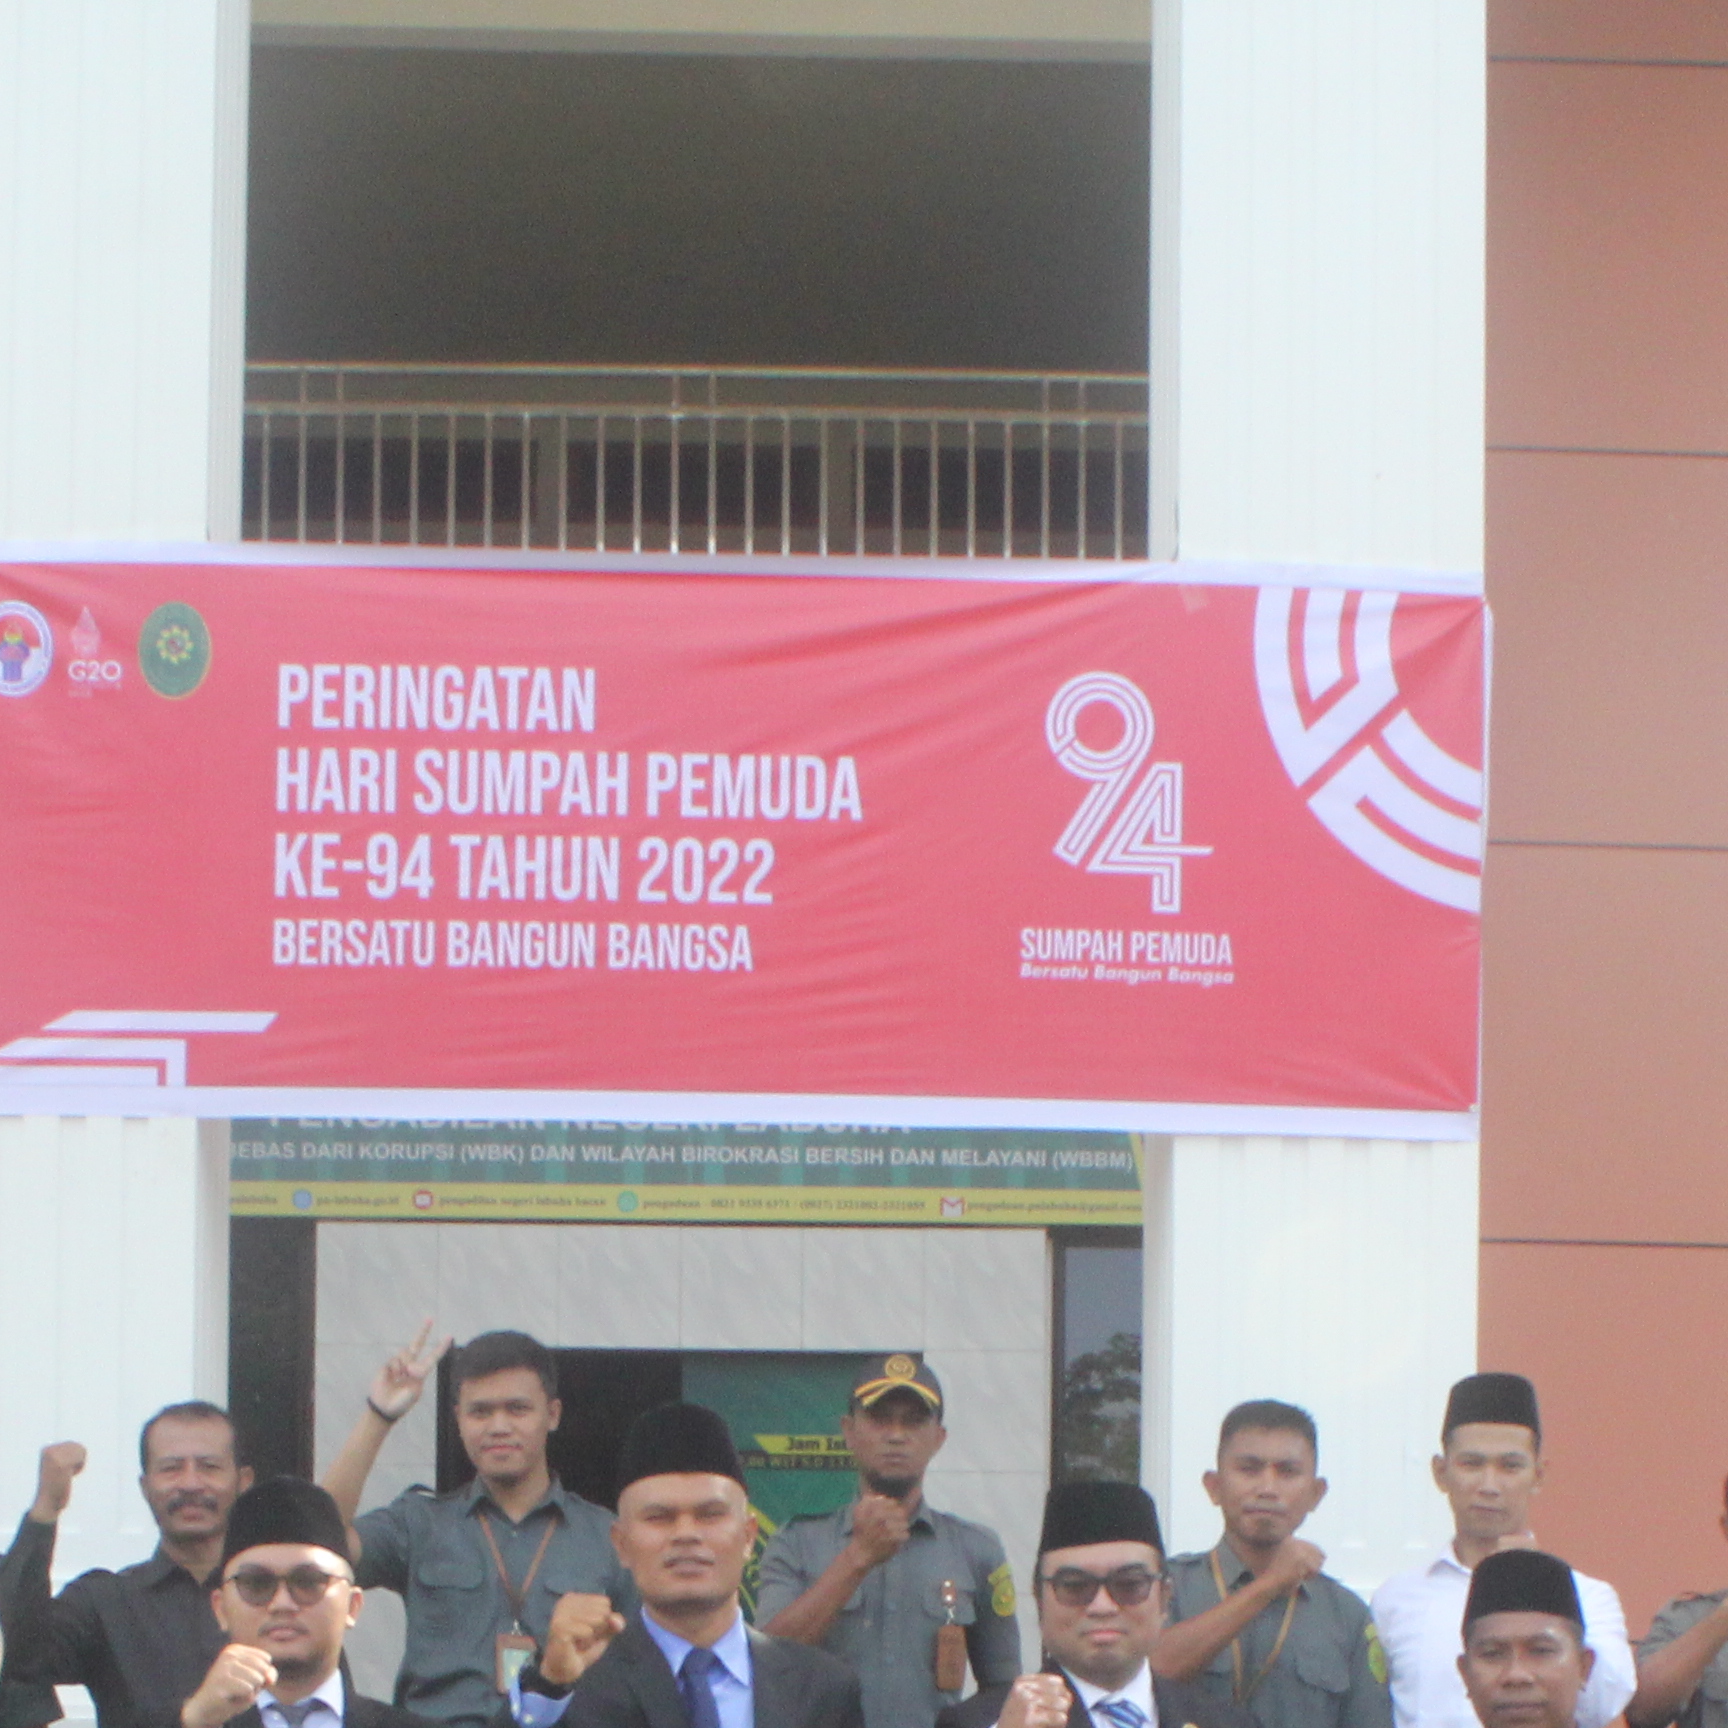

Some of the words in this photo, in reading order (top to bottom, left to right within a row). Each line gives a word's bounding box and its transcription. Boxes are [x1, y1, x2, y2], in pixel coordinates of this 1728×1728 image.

[68, 660, 123, 683] G20
[277, 664, 595, 732] PERINGATAN
[275, 748, 398, 813] HARI
[413, 750, 629, 817] SUMPAH
[646, 753, 863, 822] PEMUDA
[1045, 671, 1214, 914] 94
[273, 833, 435, 900] KE-94
[449, 835, 620, 902] TAHUN
[636, 837, 774, 905] 2022
[273, 920, 436, 967] BERSATU
[446, 921, 596, 970] BANGUN
[608, 922, 754, 973] BANGSA
[1020, 927, 1124, 962] SUMPAH
[1129, 930, 1234, 966] PEMUDA
[1020, 962, 1089, 980] Bersatu
[1093, 964, 1162, 985] Bangun
[1167, 966, 1235, 988] Bangsa
[302, 1142, 353, 1160] DARI
[360, 1142, 455, 1161] KORUPSI
[461, 1143, 524, 1165] (WBK)
[530, 1145, 576, 1162] DAN
[581, 1145, 675, 1163] WILAYAH
[682, 1146, 799, 1164] BIROKRASI
[805, 1147, 884, 1165] BERSIH
[891, 1149, 935, 1166] DAN
[941, 1149, 1047, 1167] MELAYANI
[1052, 1151, 1134, 1174] (WBBM)
